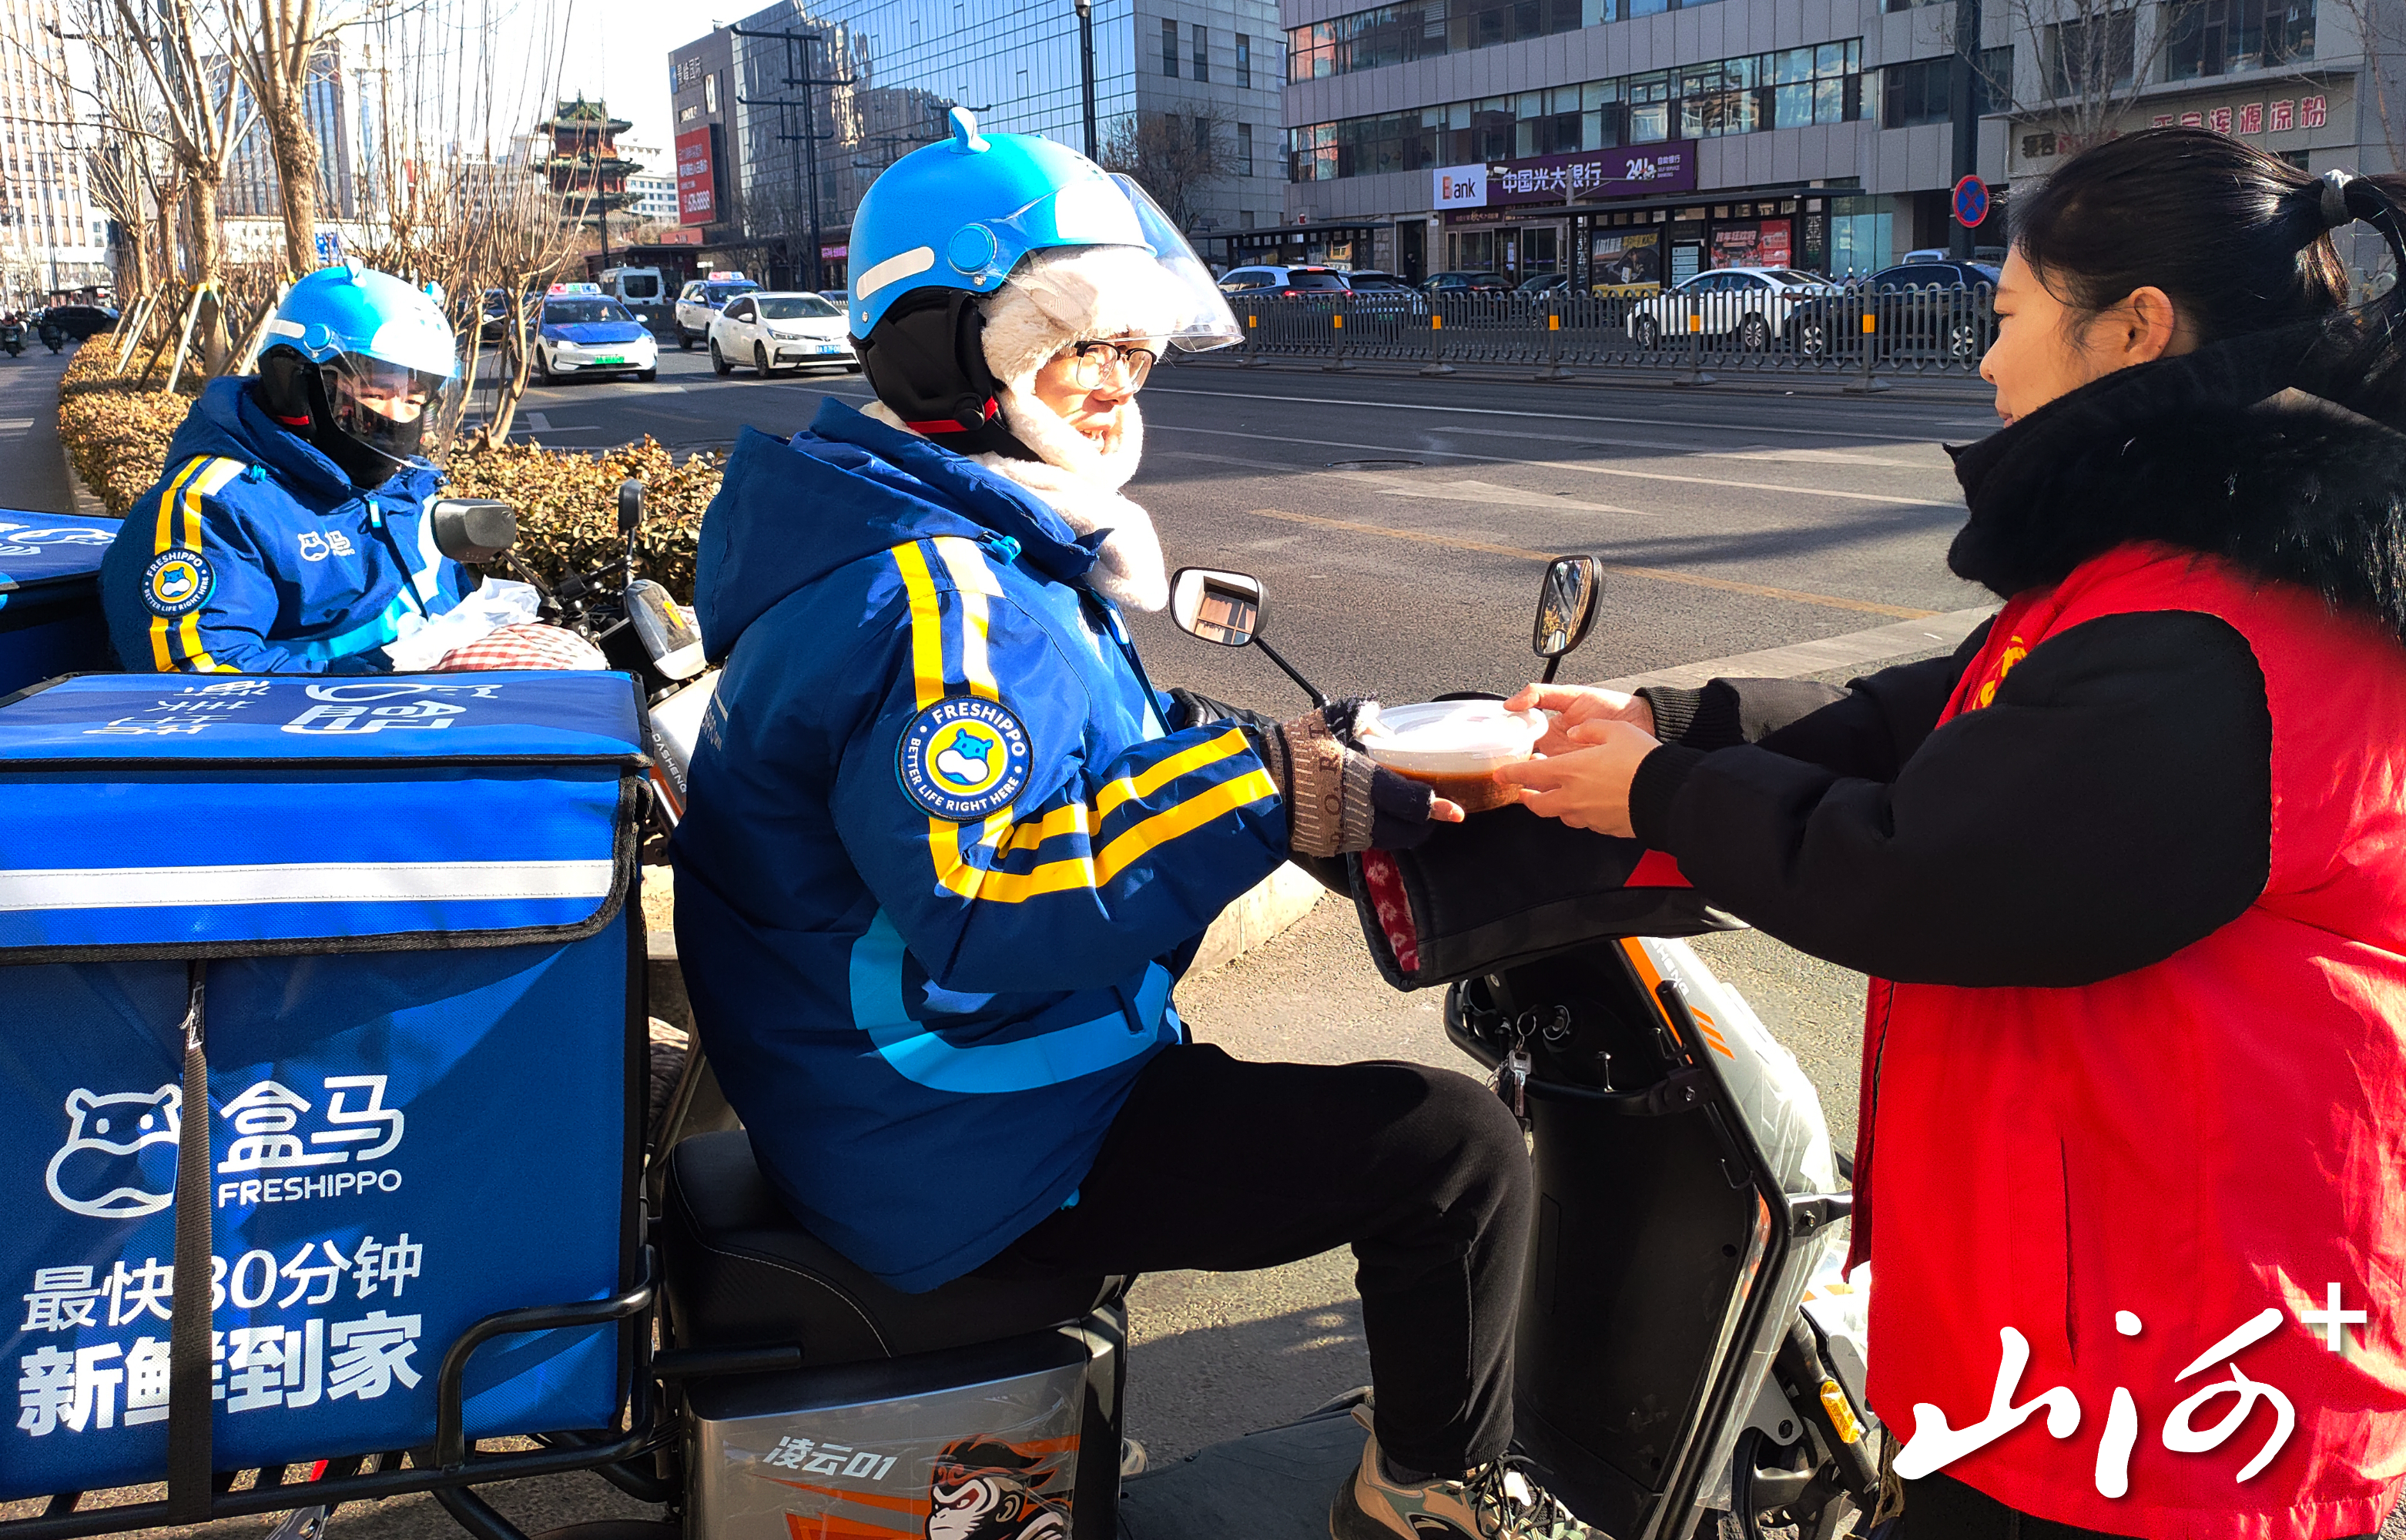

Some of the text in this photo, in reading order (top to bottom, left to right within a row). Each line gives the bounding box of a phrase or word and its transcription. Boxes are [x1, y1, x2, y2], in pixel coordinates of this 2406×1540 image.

[1443, 176, 1476, 199] Bank
[1503, 162, 1602, 194] 中国光大银行
[146, 552, 203, 578] FRESHIPPO
[144, 588, 161, 610] BETTER
[178, 594, 200, 611] RIGHT
[198, 576, 209, 595] HERE
[280, 700, 467, 735] 盒马
[932, 702, 1026, 756] FRESHIPPO
[652, 733, 687, 793] DASHENG
[908, 738, 1020, 812] BETTER LIFE RIGHT HERE
[218, 1074, 405, 1174] 盒马
[218, 1169, 402, 1208] FRESHIPPO
[21, 1234, 423, 1332] 最快30分钟
[762, 1436, 898, 1481] 凌云01
